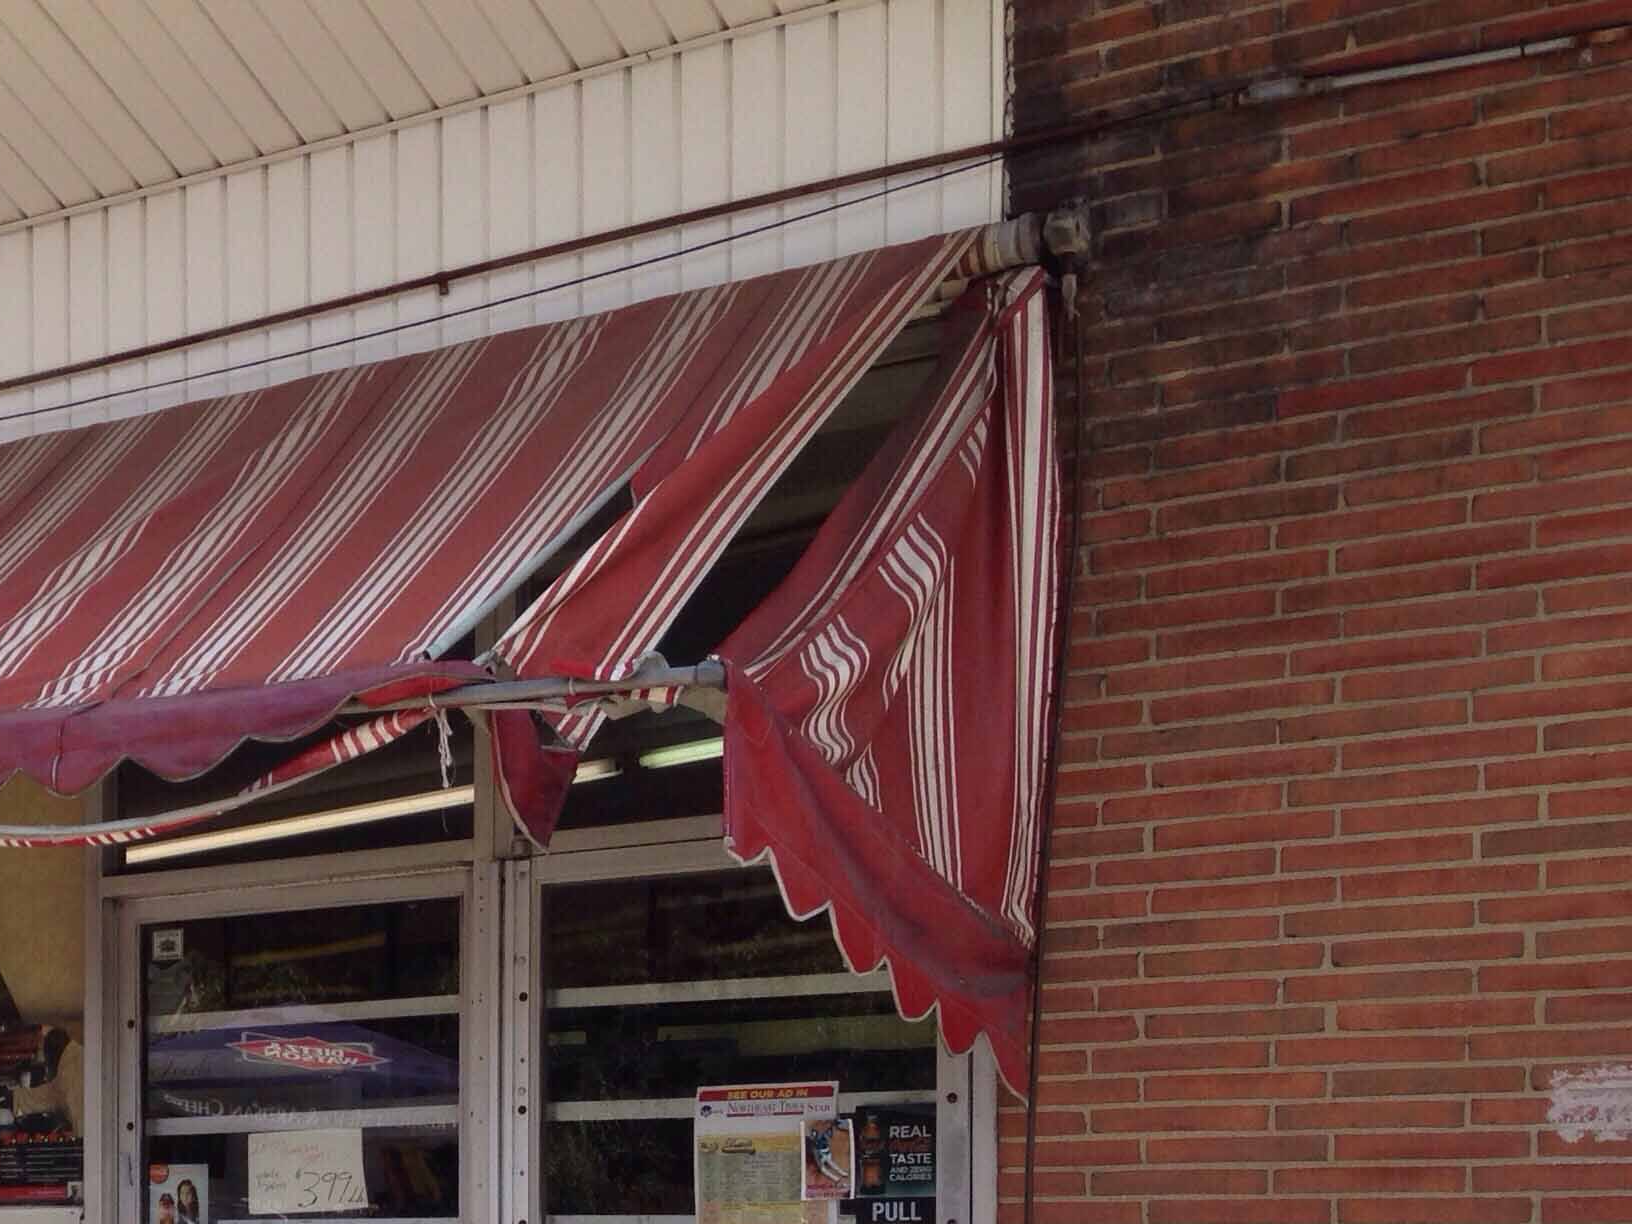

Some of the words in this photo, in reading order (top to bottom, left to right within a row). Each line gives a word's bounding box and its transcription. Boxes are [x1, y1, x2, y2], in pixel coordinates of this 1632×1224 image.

[889, 1125, 932, 1138] REAL
[889, 1152, 932, 1165] TASTE
[871, 1201, 922, 1222] PULL
